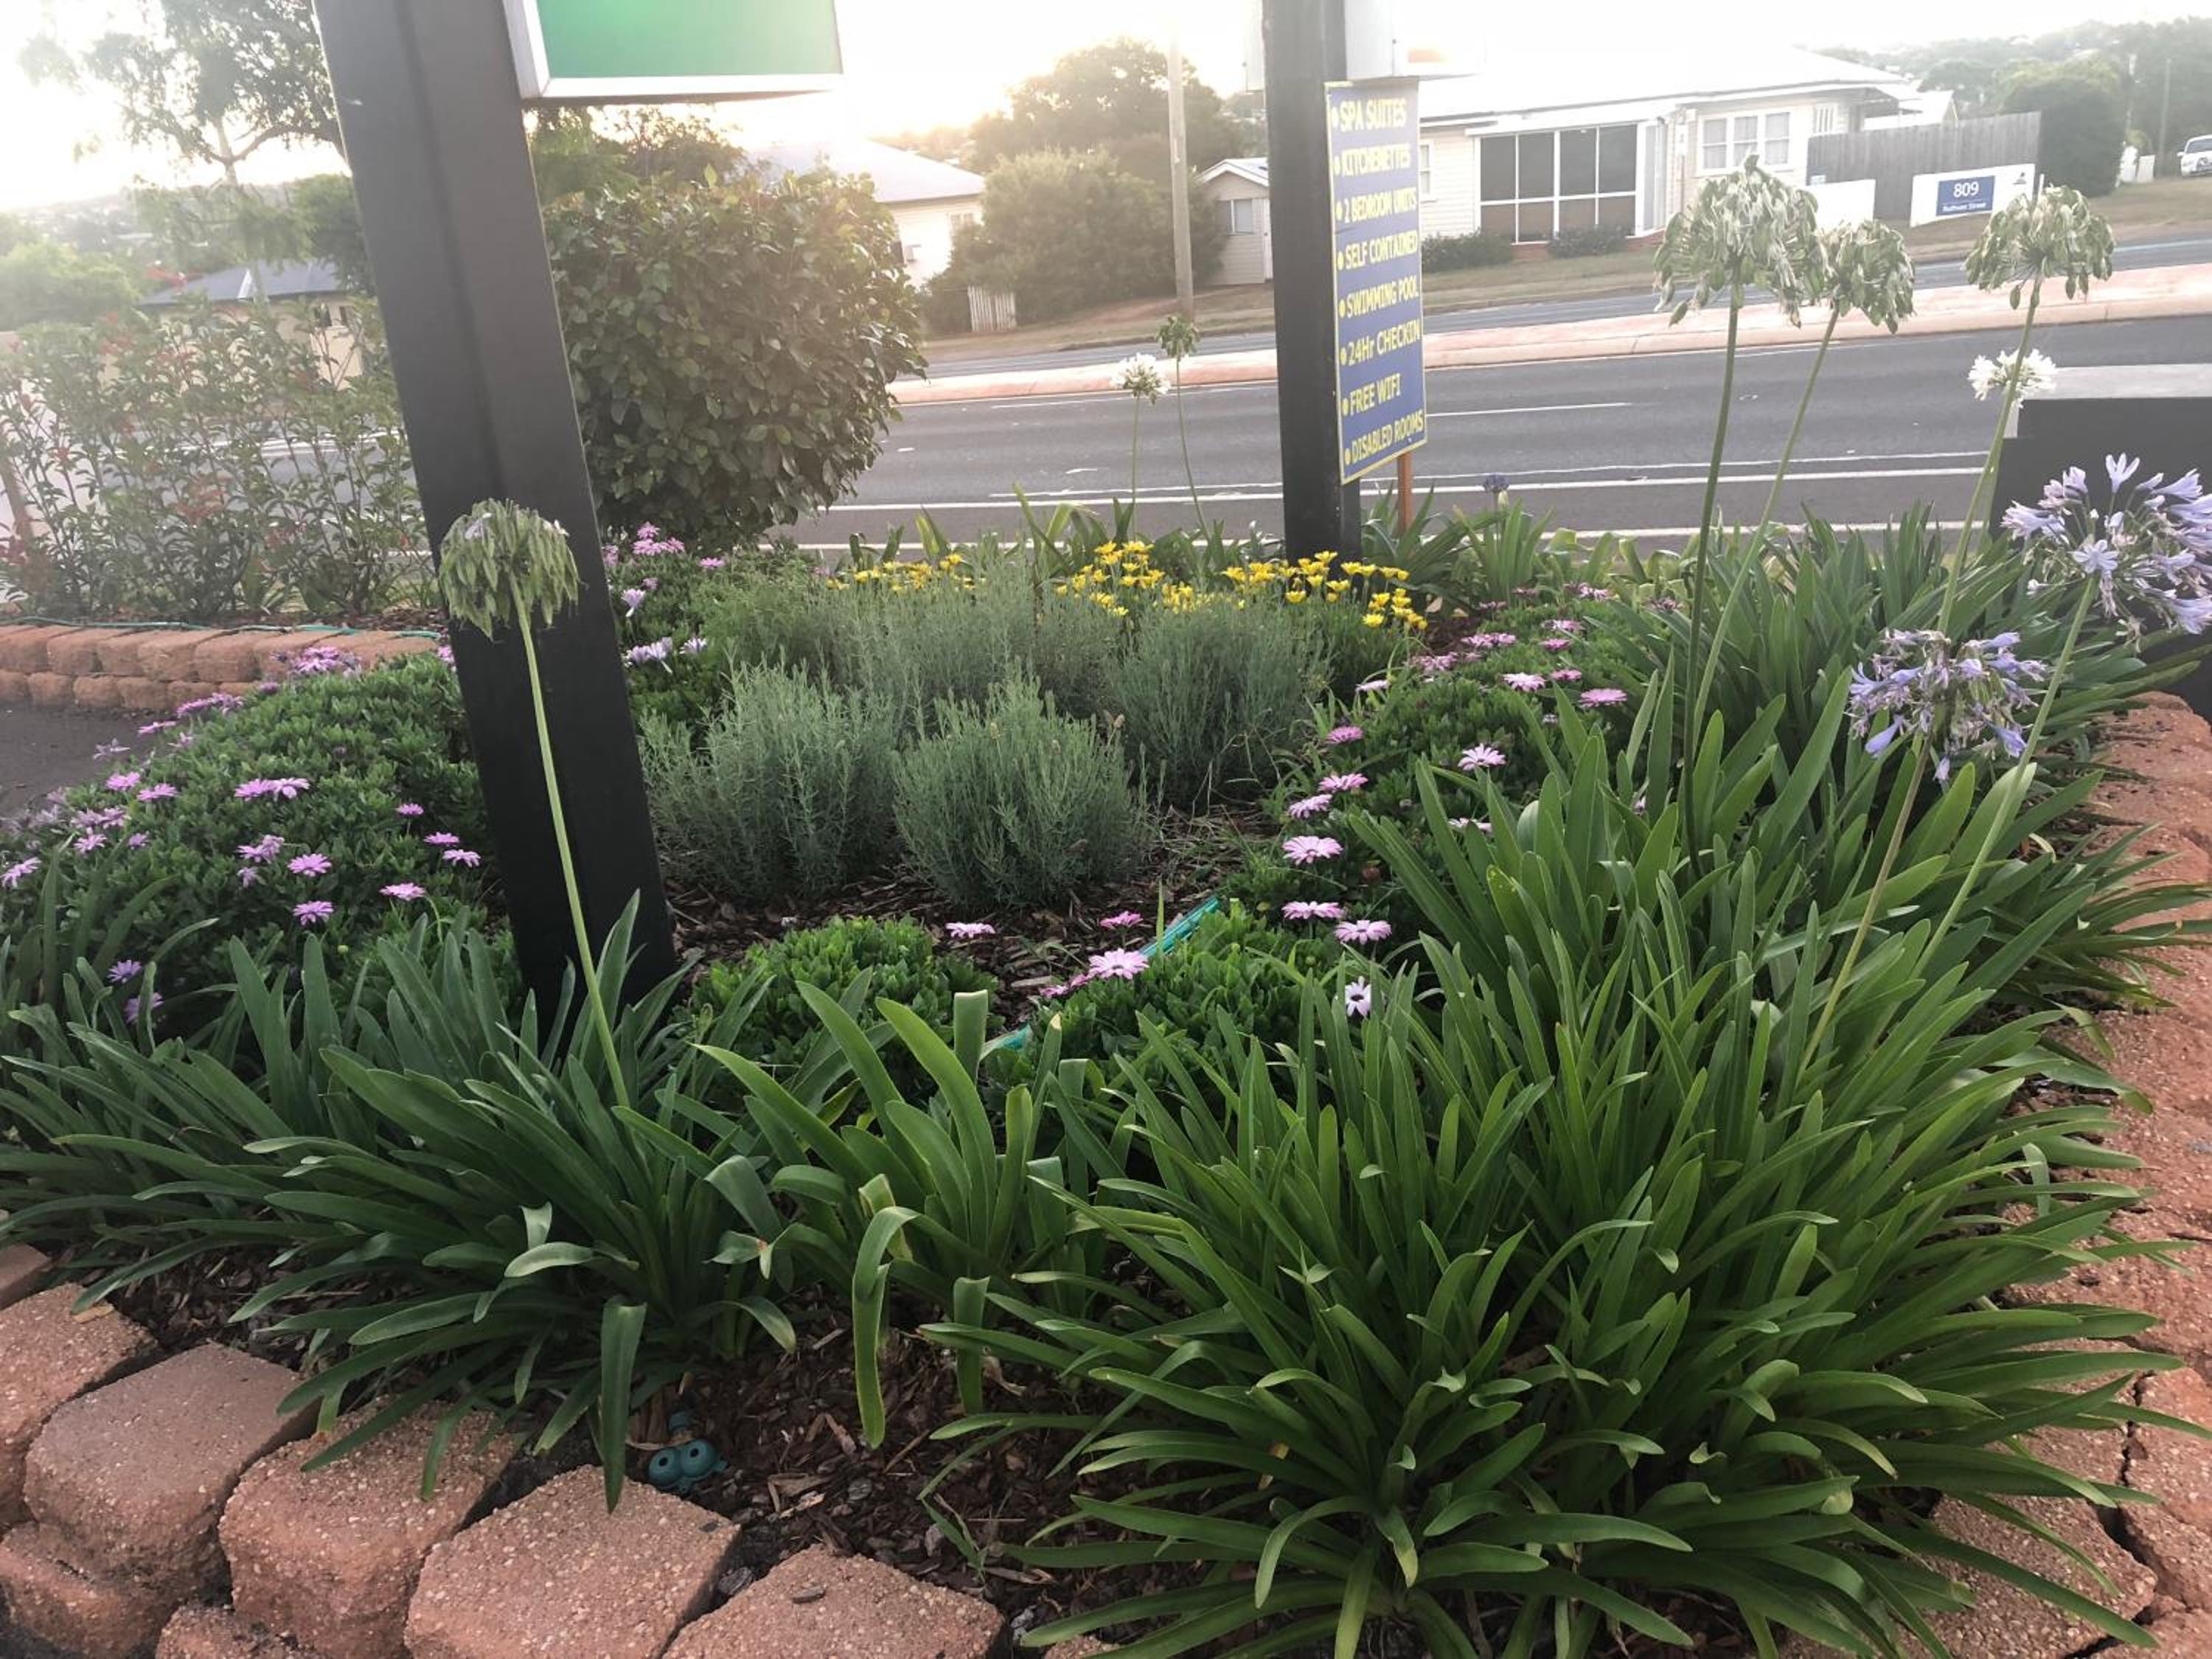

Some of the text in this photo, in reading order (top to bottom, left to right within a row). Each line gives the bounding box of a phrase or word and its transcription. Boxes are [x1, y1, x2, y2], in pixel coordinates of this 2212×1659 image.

[1339, 97, 1407, 131] SPA SUITES
[1342, 144, 1410, 176] KITCHENETTES
[1344, 187, 1417, 224] 2 BEDROOM UNITS
[1953, 181, 1979, 198] 809
[1346, 229, 1418, 270] SELF CONTAINED
[1346, 275, 1419, 319] SWIMMING POOL
[1348, 319, 1420, 366] 24Hr CHECKIN
[1349, 372, 1402, 416] FREE WIFI
[1351, 408, 1425, 465] DISABLED ROOMS
